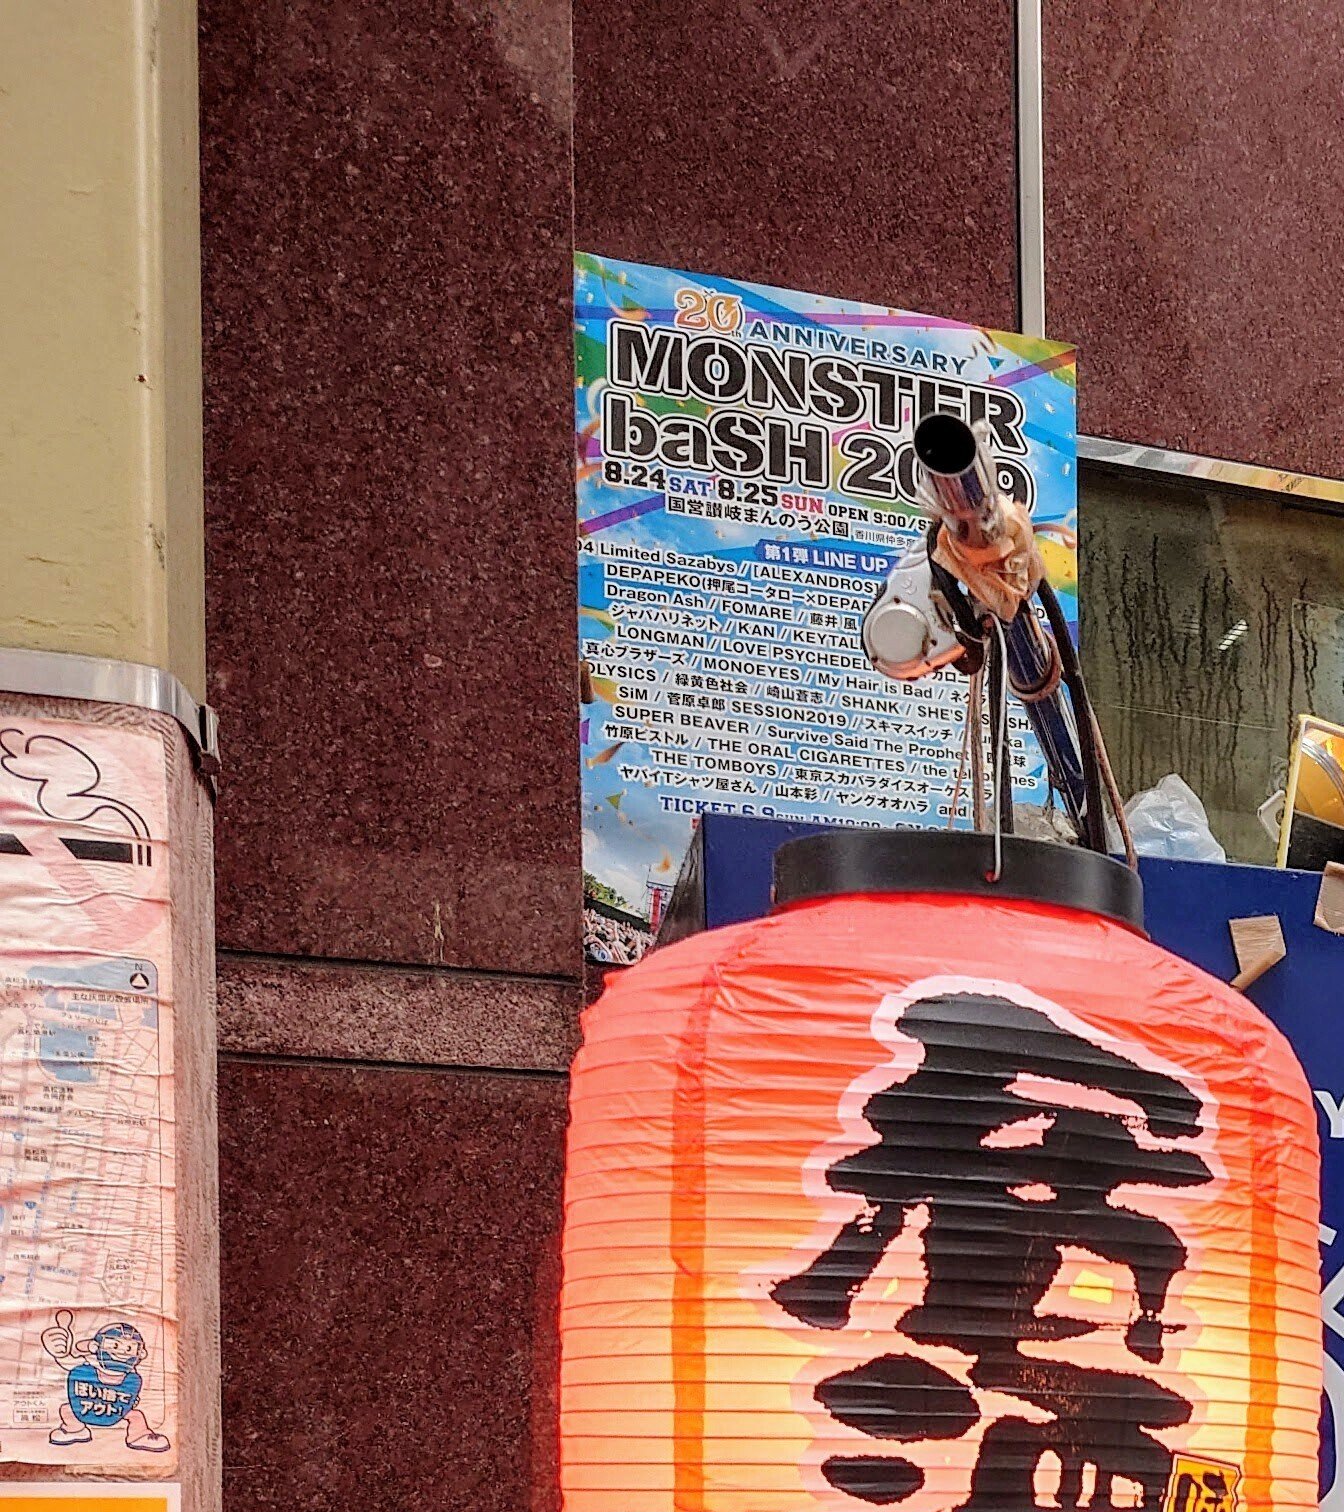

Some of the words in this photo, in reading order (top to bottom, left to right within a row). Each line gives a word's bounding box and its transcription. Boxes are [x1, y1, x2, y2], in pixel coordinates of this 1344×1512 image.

[750, 320, 967, 375] ANNIVERSARY
[604, 462, 665, 490] 8.24
[669, 477, 711, 496] SAT
[718, 480, 779, 506] 8.25
[781, 492, 824, 514] SUN
[829, 505, 870, 523] OPEN
[668, 497, 850, 537] 国営讃岐まんのう公園
[600, 543, 660, 562] Limited
[666, 553, 735, 574] Sazabys
[764, 544, 809, 564] 第1弾
[812, 549, 855, 569] LINE
[860, 556, 888, 573] UP
[606, 584, 667, 603] Dragon
[673, 592, 704, 609] Ash
[721, 600, 793, 621] FOMARE
[617, 625, 704, 649] LONGMAN
[723, 640, 766, 657] LOVE
[738, 623, 775, 638] KAN
[585, 642, 685, 666] 真心ブラザーズ
[704, 657, 800, 681] MONOEYES
[818, 668, 842, 687] My
[846, 676, 879, 691] Hair
[885, 682, 898, 693] is
[903, 684, 932, 698] Bad
[618, 687, 648, 701] SiM
[732, 701, 847, 727] SESSION2019
[615, 705, 674, 724] SUPER
[681, 714, 749, 734] BEAVER
[768, 725, 829, 744] Survive
[834, 735, 868, 750] Said
[874, 739, 903, 755] The
[652, 750, 689, 766] THE
[695, 755, 777, 776] TOMBOYS
[709, 739, 742, 753] THE
[749, 742, 794, 759] ORAL
[799, 749, 905, 771] CIGARETTES
[923, 765, 947, 777] the
